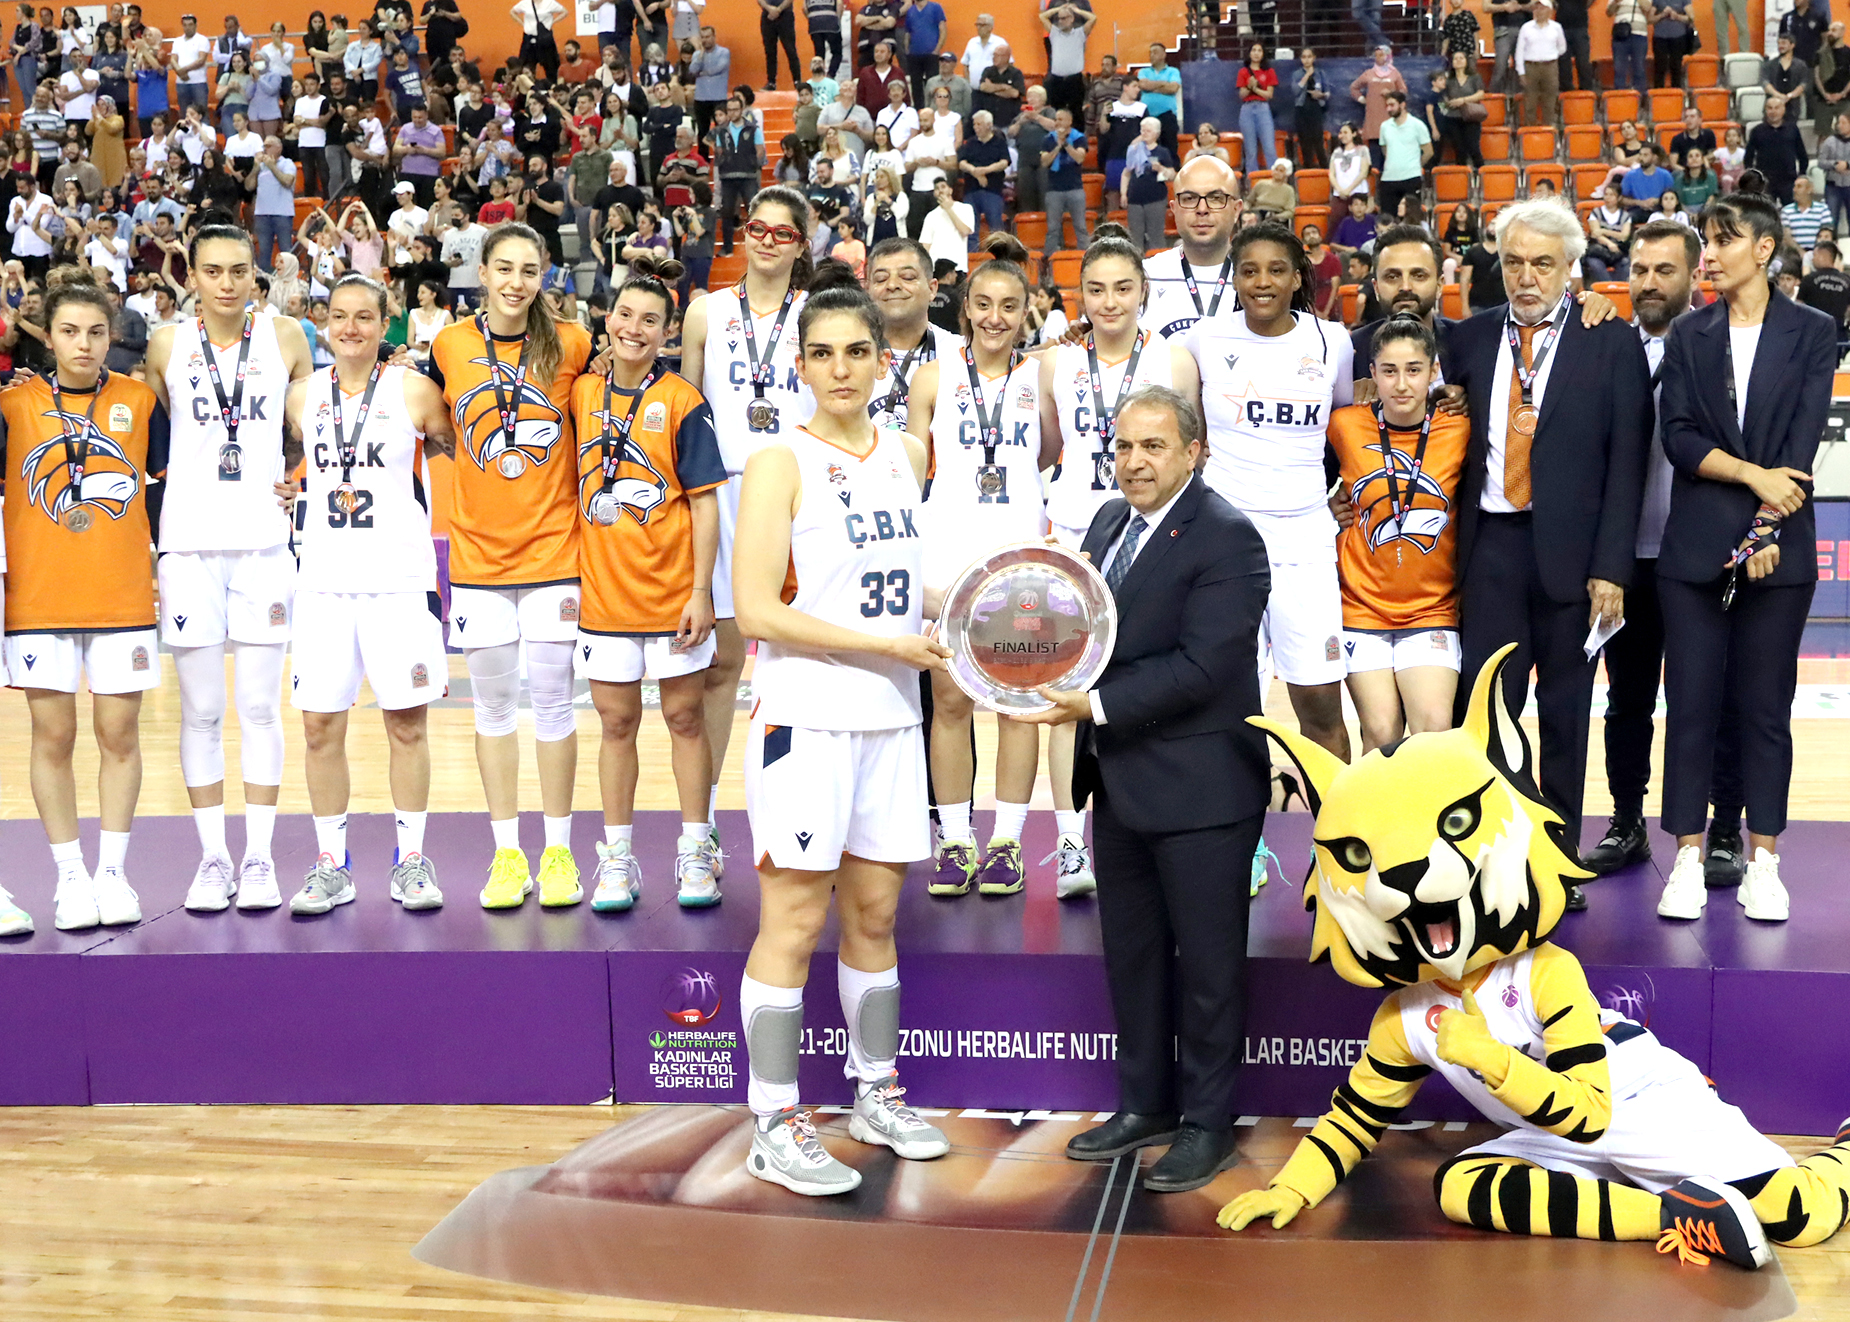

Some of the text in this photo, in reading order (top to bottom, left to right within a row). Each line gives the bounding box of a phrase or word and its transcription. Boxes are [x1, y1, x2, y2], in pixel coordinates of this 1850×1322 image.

[192, 395, 268, 426] Ç..K
[1246, 400, 1321, 428] Ç.B.K
[314, 442, 386, 473] Ç..K
[327, 490, 374, 528] 92
[844, 508, 919, 549] Ç.B.K
[860, 569, 910, 618] 33
[993, 640, 1059, 653] FİNALİST
[668, 1031, 737, 1040] HERBALIFE
[668, 1040, 737, 1048] NUTRITION
[896, 1029, 951, 1057] ZONU
[957, 1030, 1065, 1059] HERBALIFE
[1241, 1036, 1285, 1065] LAR
[649, 1063, 738, 1076] BASKETBOL
[654, 1051, 731, 1063] KADINLAR
[655, 1075, 734, 1089] SÜPER LİGİ
